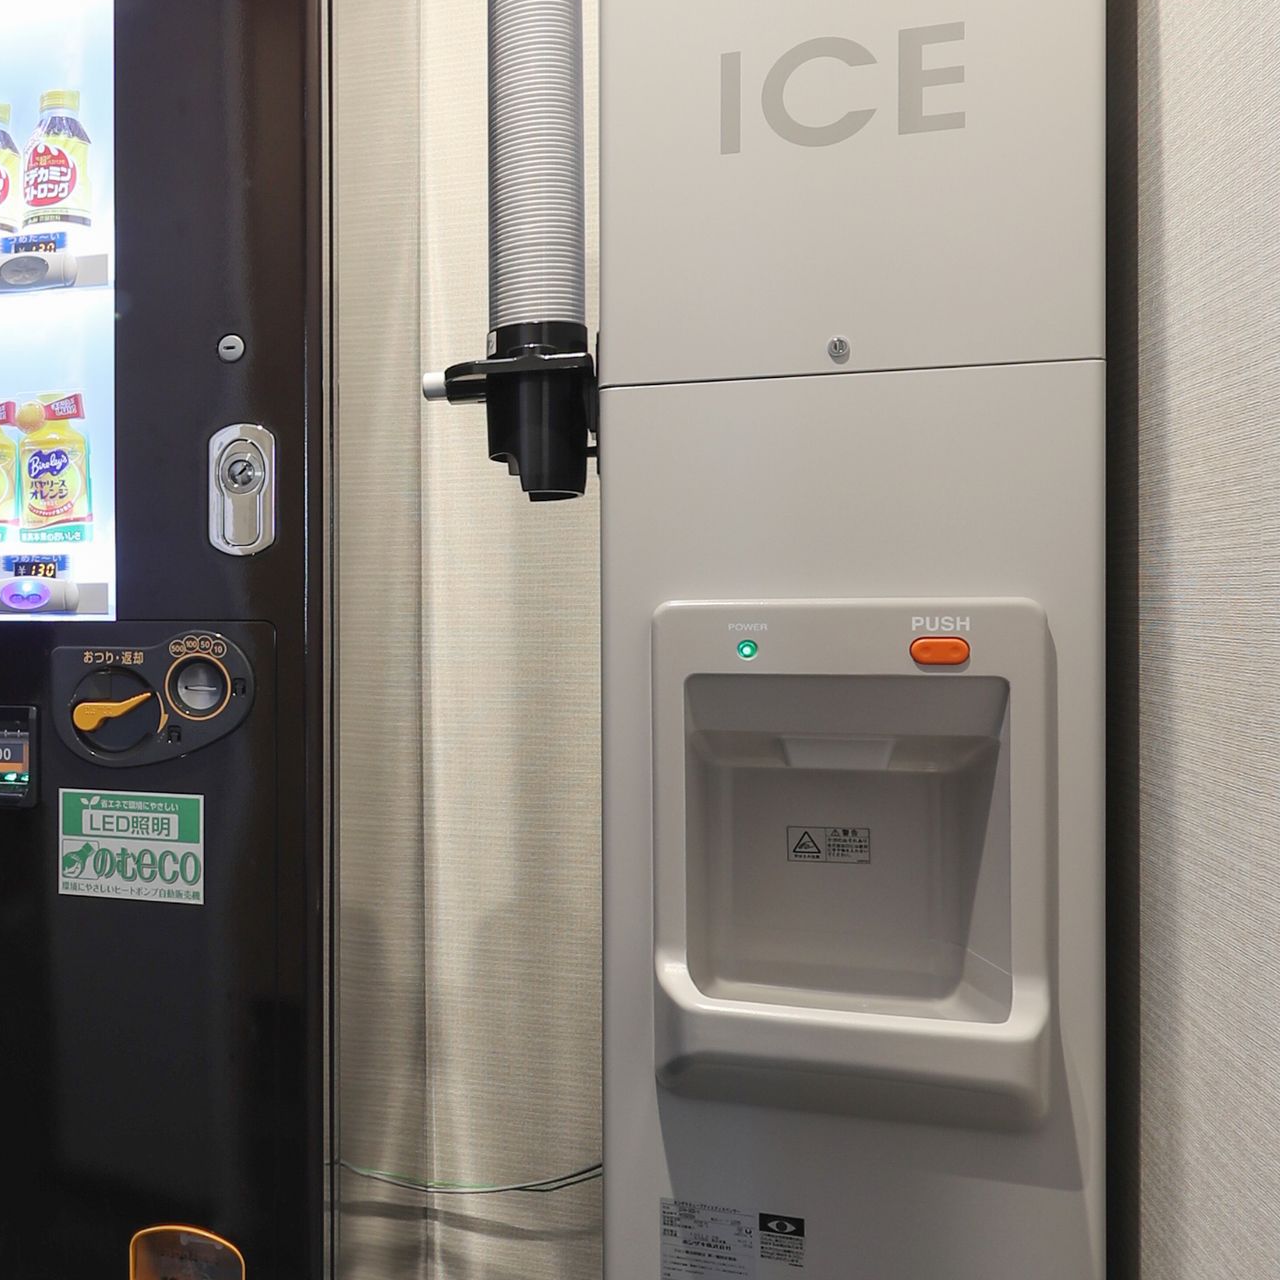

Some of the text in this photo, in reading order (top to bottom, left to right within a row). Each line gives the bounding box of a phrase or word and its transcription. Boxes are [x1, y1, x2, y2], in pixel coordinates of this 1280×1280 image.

[720, 21, 966, 156] ICE
[30, 480, 68, 490] バヤリース
[29, 489, 69, 501] オレンジ
[728, 623, 768, 631] POWER
[911, 616, 970, 632] PUSH
[171, 644, 185, 653] 500
[185, 640, 197, 648] 100
[200, 640, 210, 649] 50
[213, 645, 223, 653] 10
[83, 651, 144, 665] おつり・返却
[101, 799, 179, 812] 省エネで環境にやさしい
[90, 814, 171, 837] LED照明
